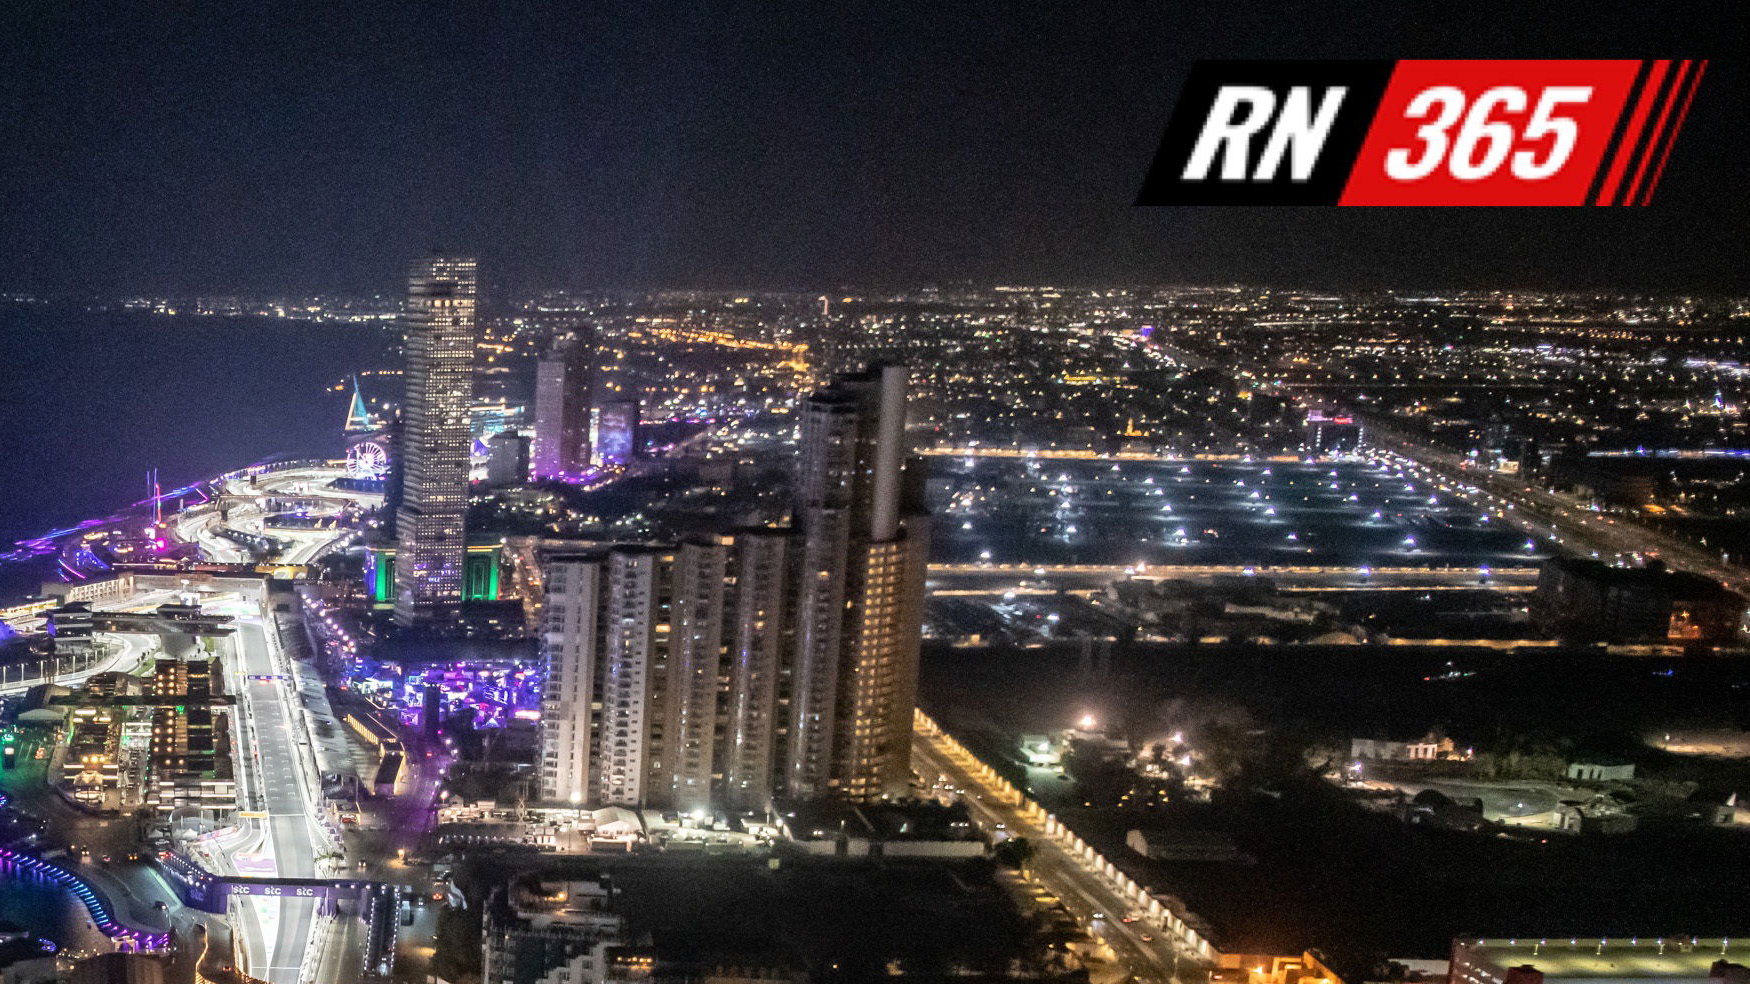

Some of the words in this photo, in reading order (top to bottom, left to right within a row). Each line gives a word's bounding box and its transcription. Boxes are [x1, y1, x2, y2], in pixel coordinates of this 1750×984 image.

[233, 885, 250, 894] stc
[264, 886, 282, 895] stc
[296, 886, 313, 896] stc
